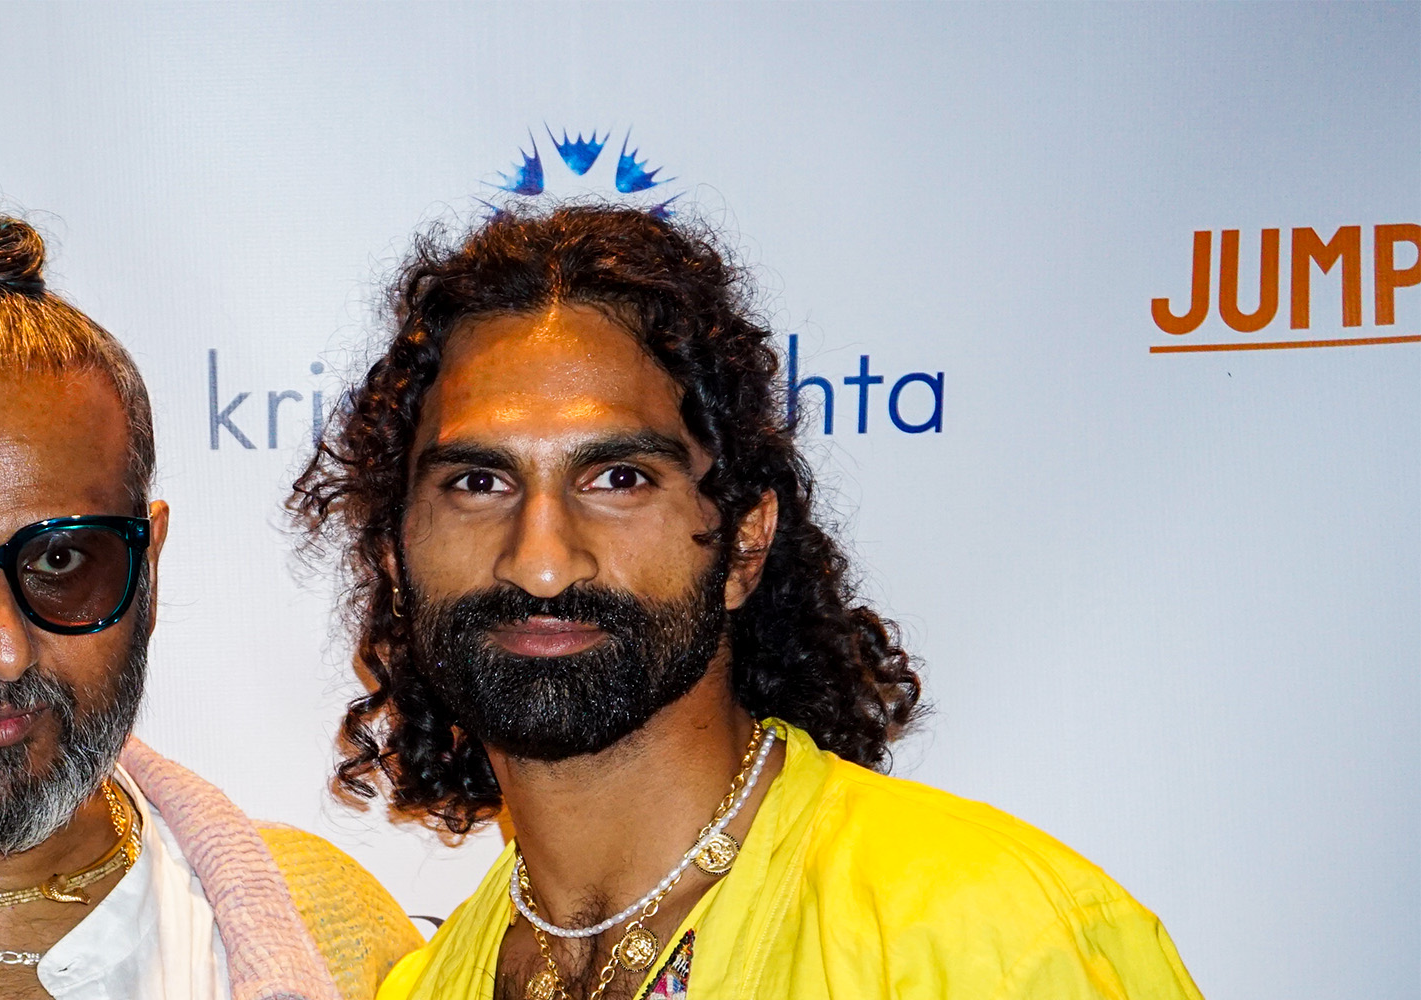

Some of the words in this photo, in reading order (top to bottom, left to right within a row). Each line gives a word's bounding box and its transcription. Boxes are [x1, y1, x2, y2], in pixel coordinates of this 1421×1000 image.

[1151, 223, 1421, 335] JUMP
[208, 348, 325, 450] kri
[787, 333, 944, 435] hta
